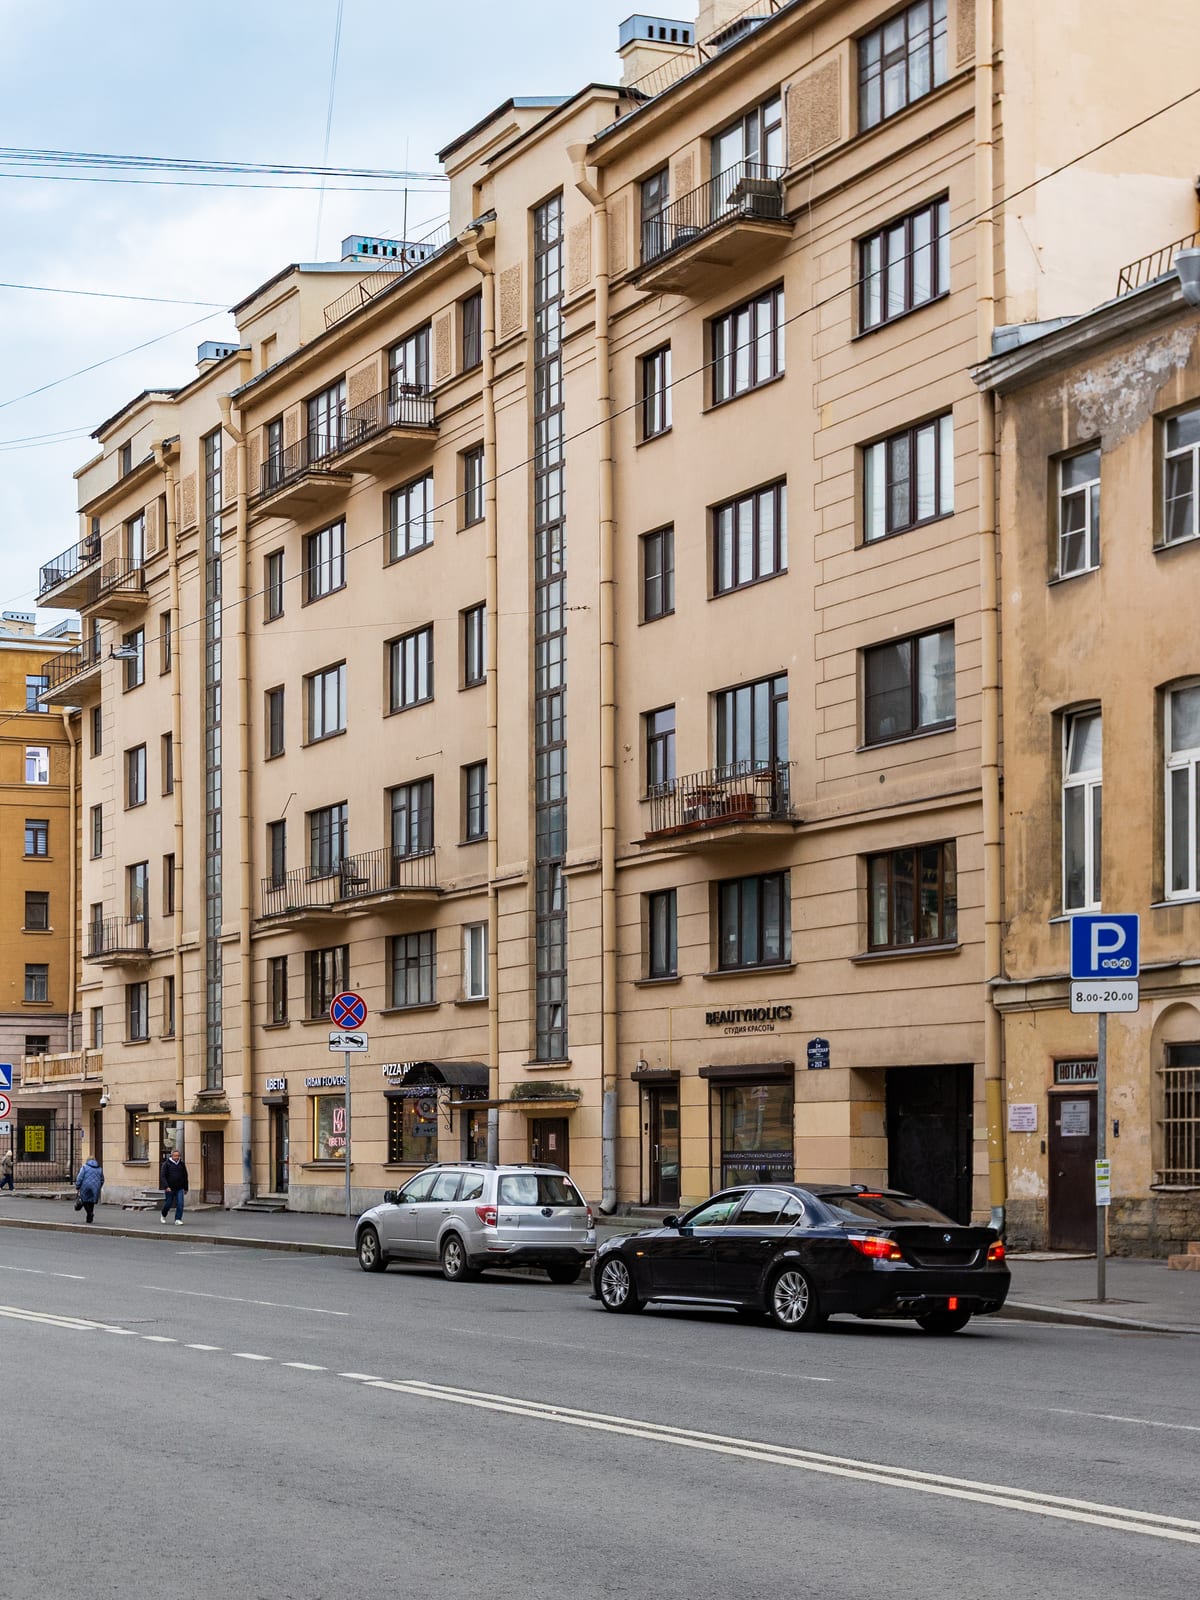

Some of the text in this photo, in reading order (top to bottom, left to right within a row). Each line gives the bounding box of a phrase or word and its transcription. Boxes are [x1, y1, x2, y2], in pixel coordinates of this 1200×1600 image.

[1091, 922, 1126, 971] P
[1120, 959, 1131, 968] 20
[1076, 991, 1133, 1002] 8.00-20.00
[705, 1005, 792, 1025] BEAUTYHOLICS
[724, 1024, 775, 1035] СТУДИЯ КРАСОТЫ
[382, 1064, 401, 1077] PIZZA
[1059, 1063, 1098, 1080] НОТАРИУ
[265, 1079, 286, 1091] ЦВЕТЫ
[304, 1075, 347, 1088] URBAN FLOWERS
